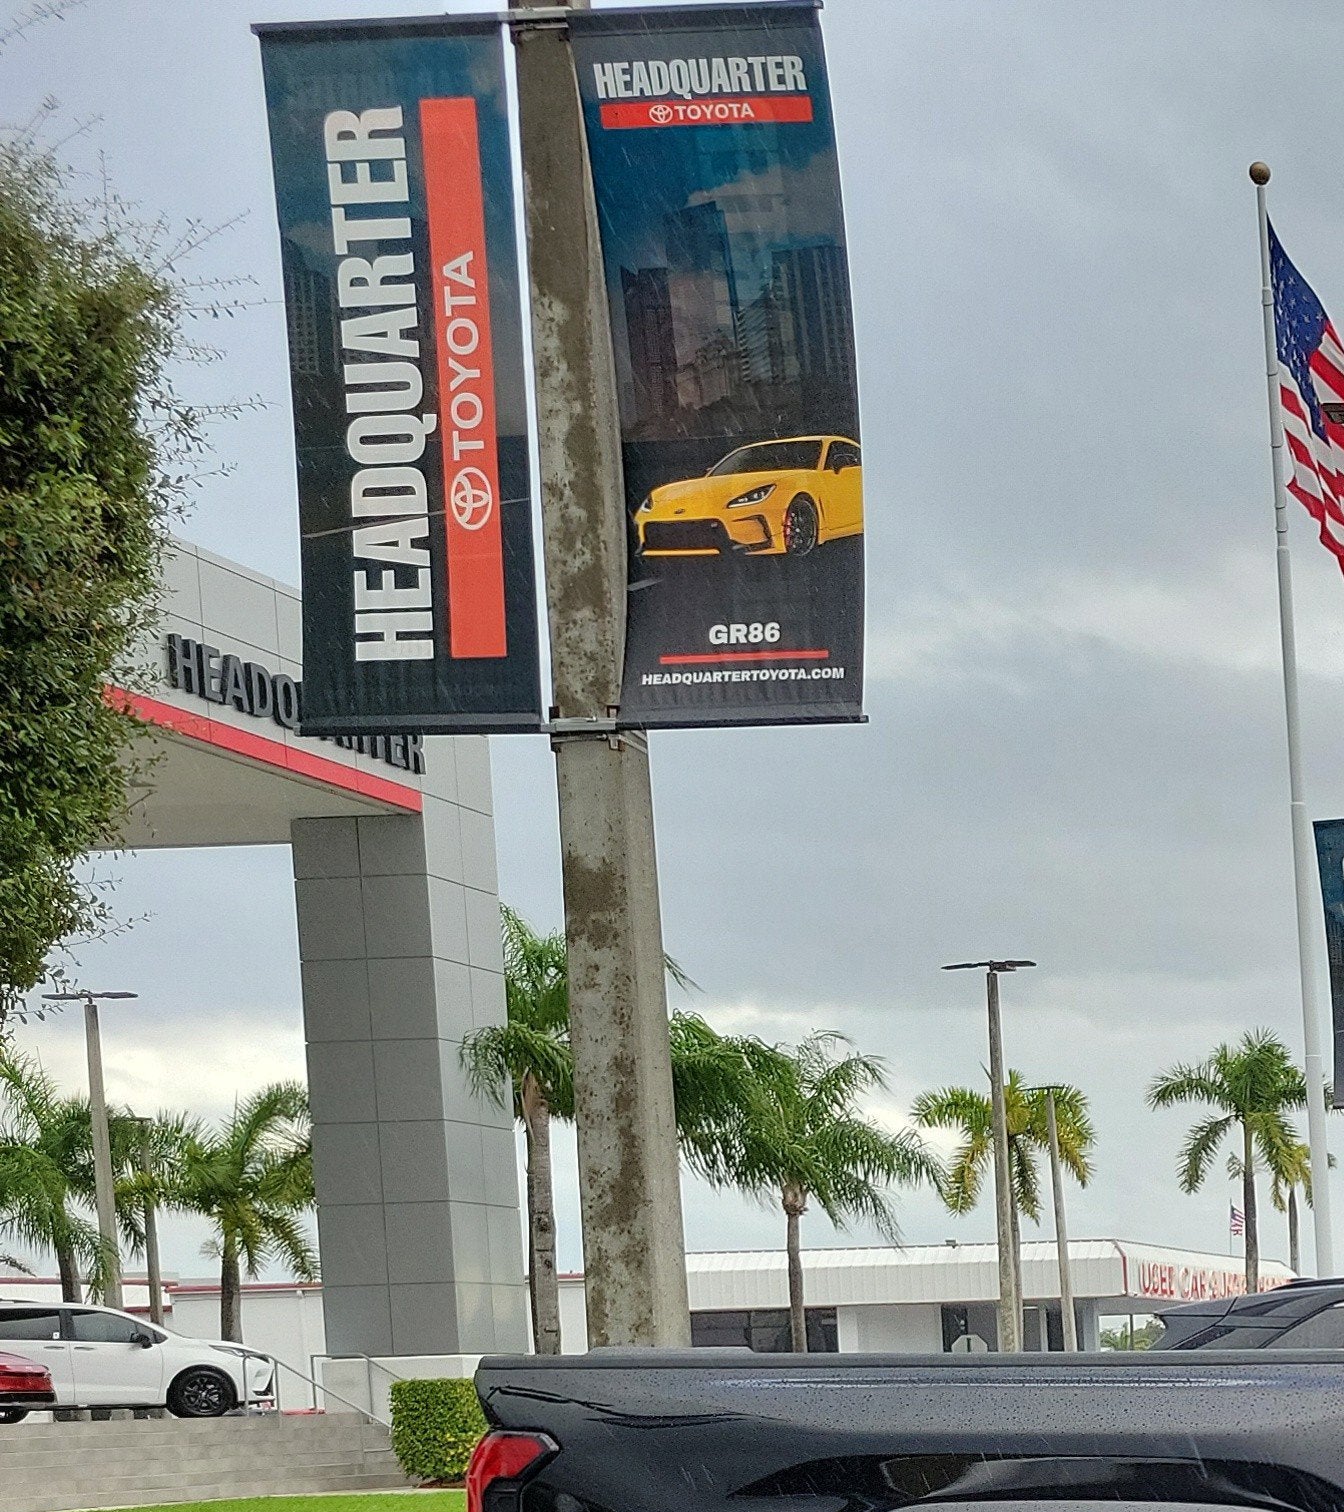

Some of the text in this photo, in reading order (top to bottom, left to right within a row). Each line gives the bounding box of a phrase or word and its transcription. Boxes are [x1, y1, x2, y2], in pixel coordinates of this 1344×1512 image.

[593, 55, 808, 99] HEADQUARTER
[674, 103, 755, 120] TOYOTA
[442, 250, 486, 461] TOYOTA
[324, 105, 438, 661] HEADQUARTER
[708, 622, 781, 645] GR86
[641, 667, 845, 686] HEADQUARTERTOYOTA.COM
